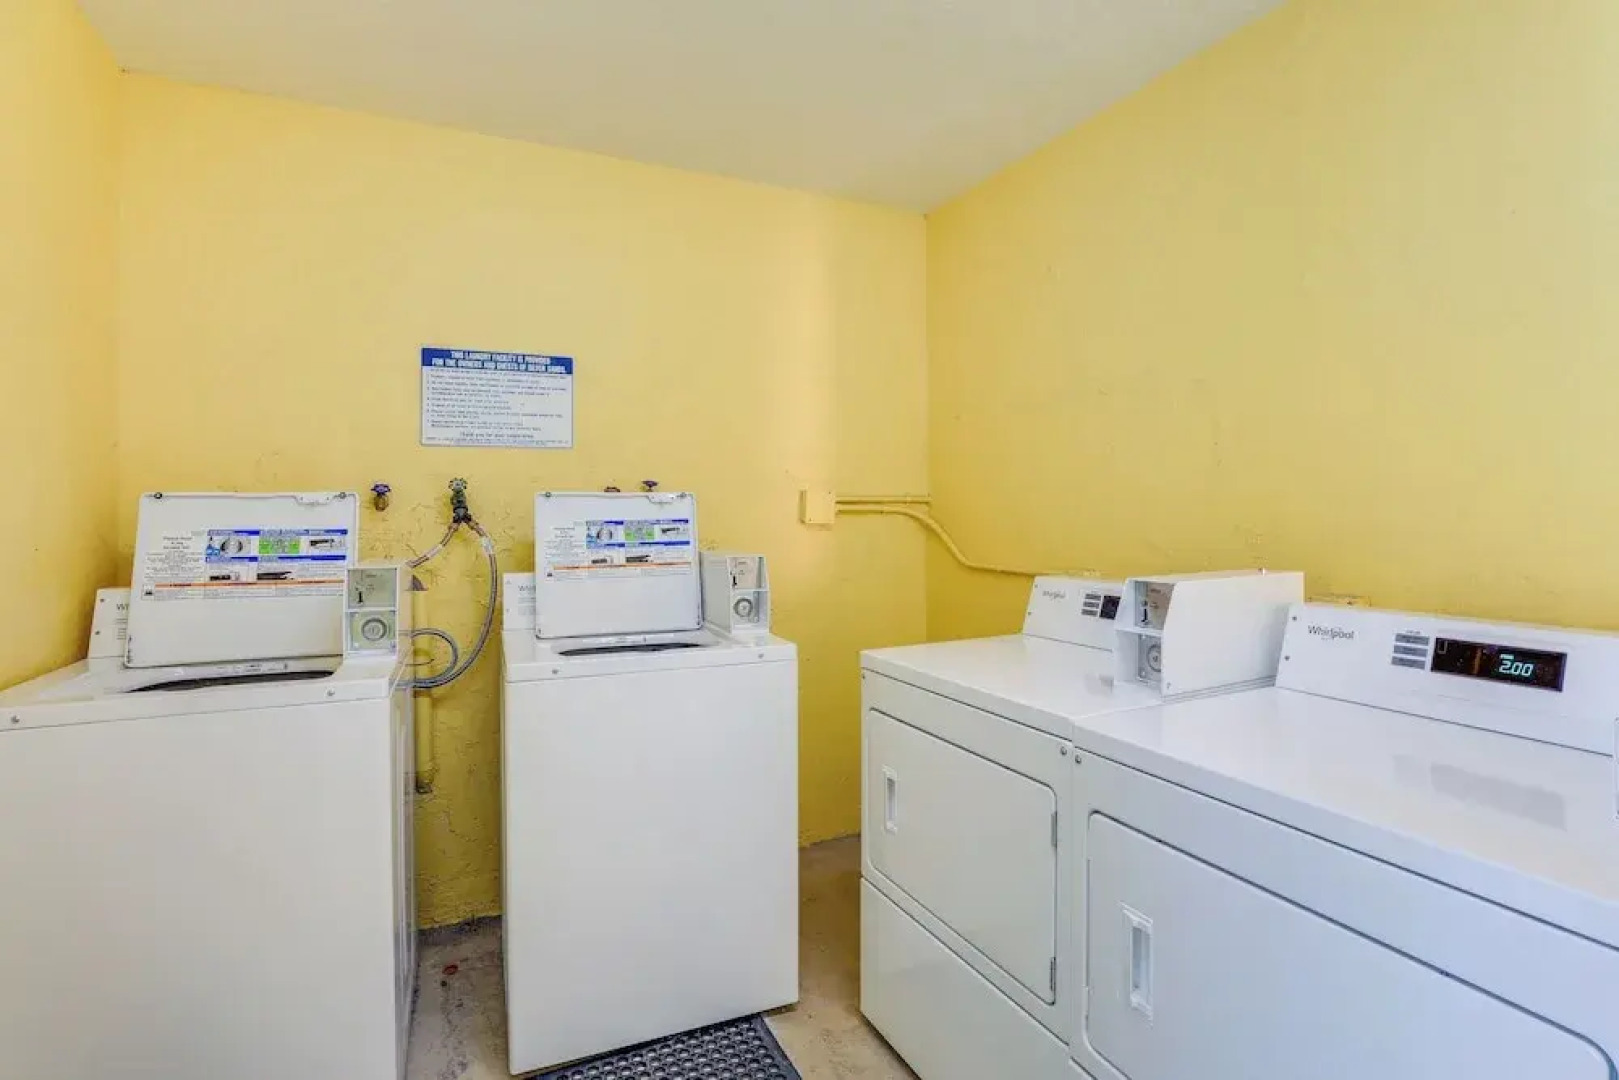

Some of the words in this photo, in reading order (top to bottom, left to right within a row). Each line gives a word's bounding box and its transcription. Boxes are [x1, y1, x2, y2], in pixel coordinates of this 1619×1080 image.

[431, 357, 444, 367] FOR
[445, 358, 456, 367] THE
[457, 359, 482, 369] OWNERS
[483, 360, 496, 370] AND
[496, 361, 518, 371] GUESTS
[451, 351, 464, 359] THIS
[465, 351, 491, 361] LAUNDRY
[492, 352, 516, 362] FACILITY
[524, 355, 551, 365] PROVIDED
[1307, 624, 1355, 640] Whirlpool
